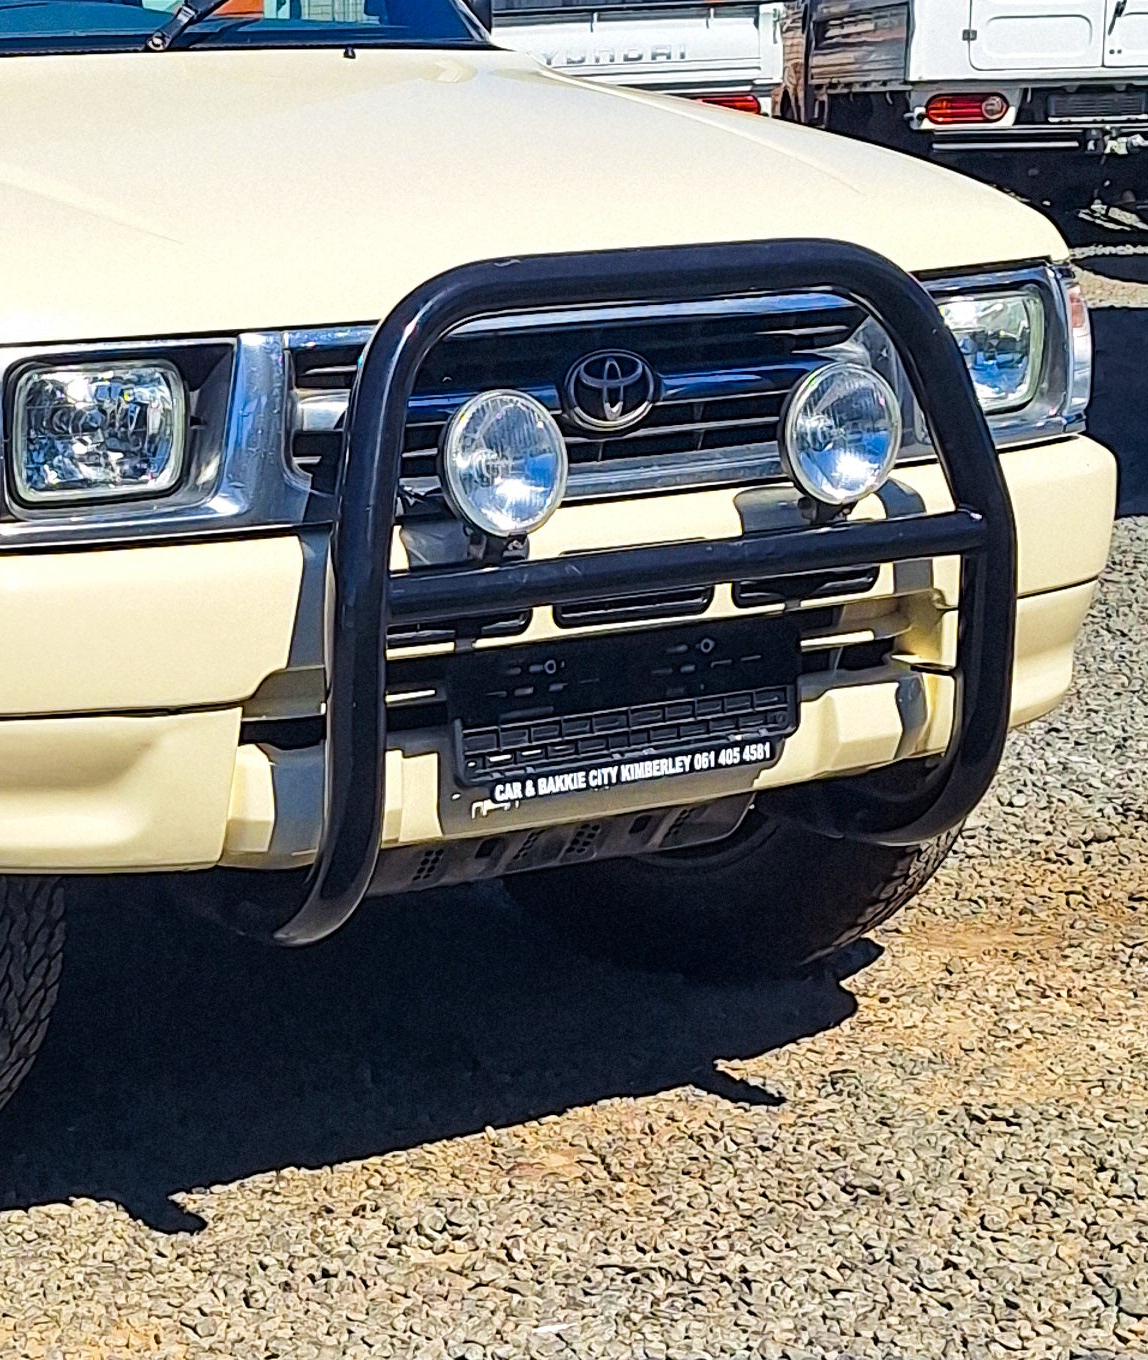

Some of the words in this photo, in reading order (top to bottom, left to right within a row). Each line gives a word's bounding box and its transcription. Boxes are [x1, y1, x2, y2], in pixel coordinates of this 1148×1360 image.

[542, 44, 686, 65] YUNDAI
[494, 781, 523, 801] CAR
[524, 779, 536, 797] &
[537, 771, 587, 795] BAKKIE
[588, 766, 619, 787] CITY
[620, 755, 692, 782] KIMBERLEY
[718, 747, 741, 766] 405
[742, 742, 771, 761] 4581
